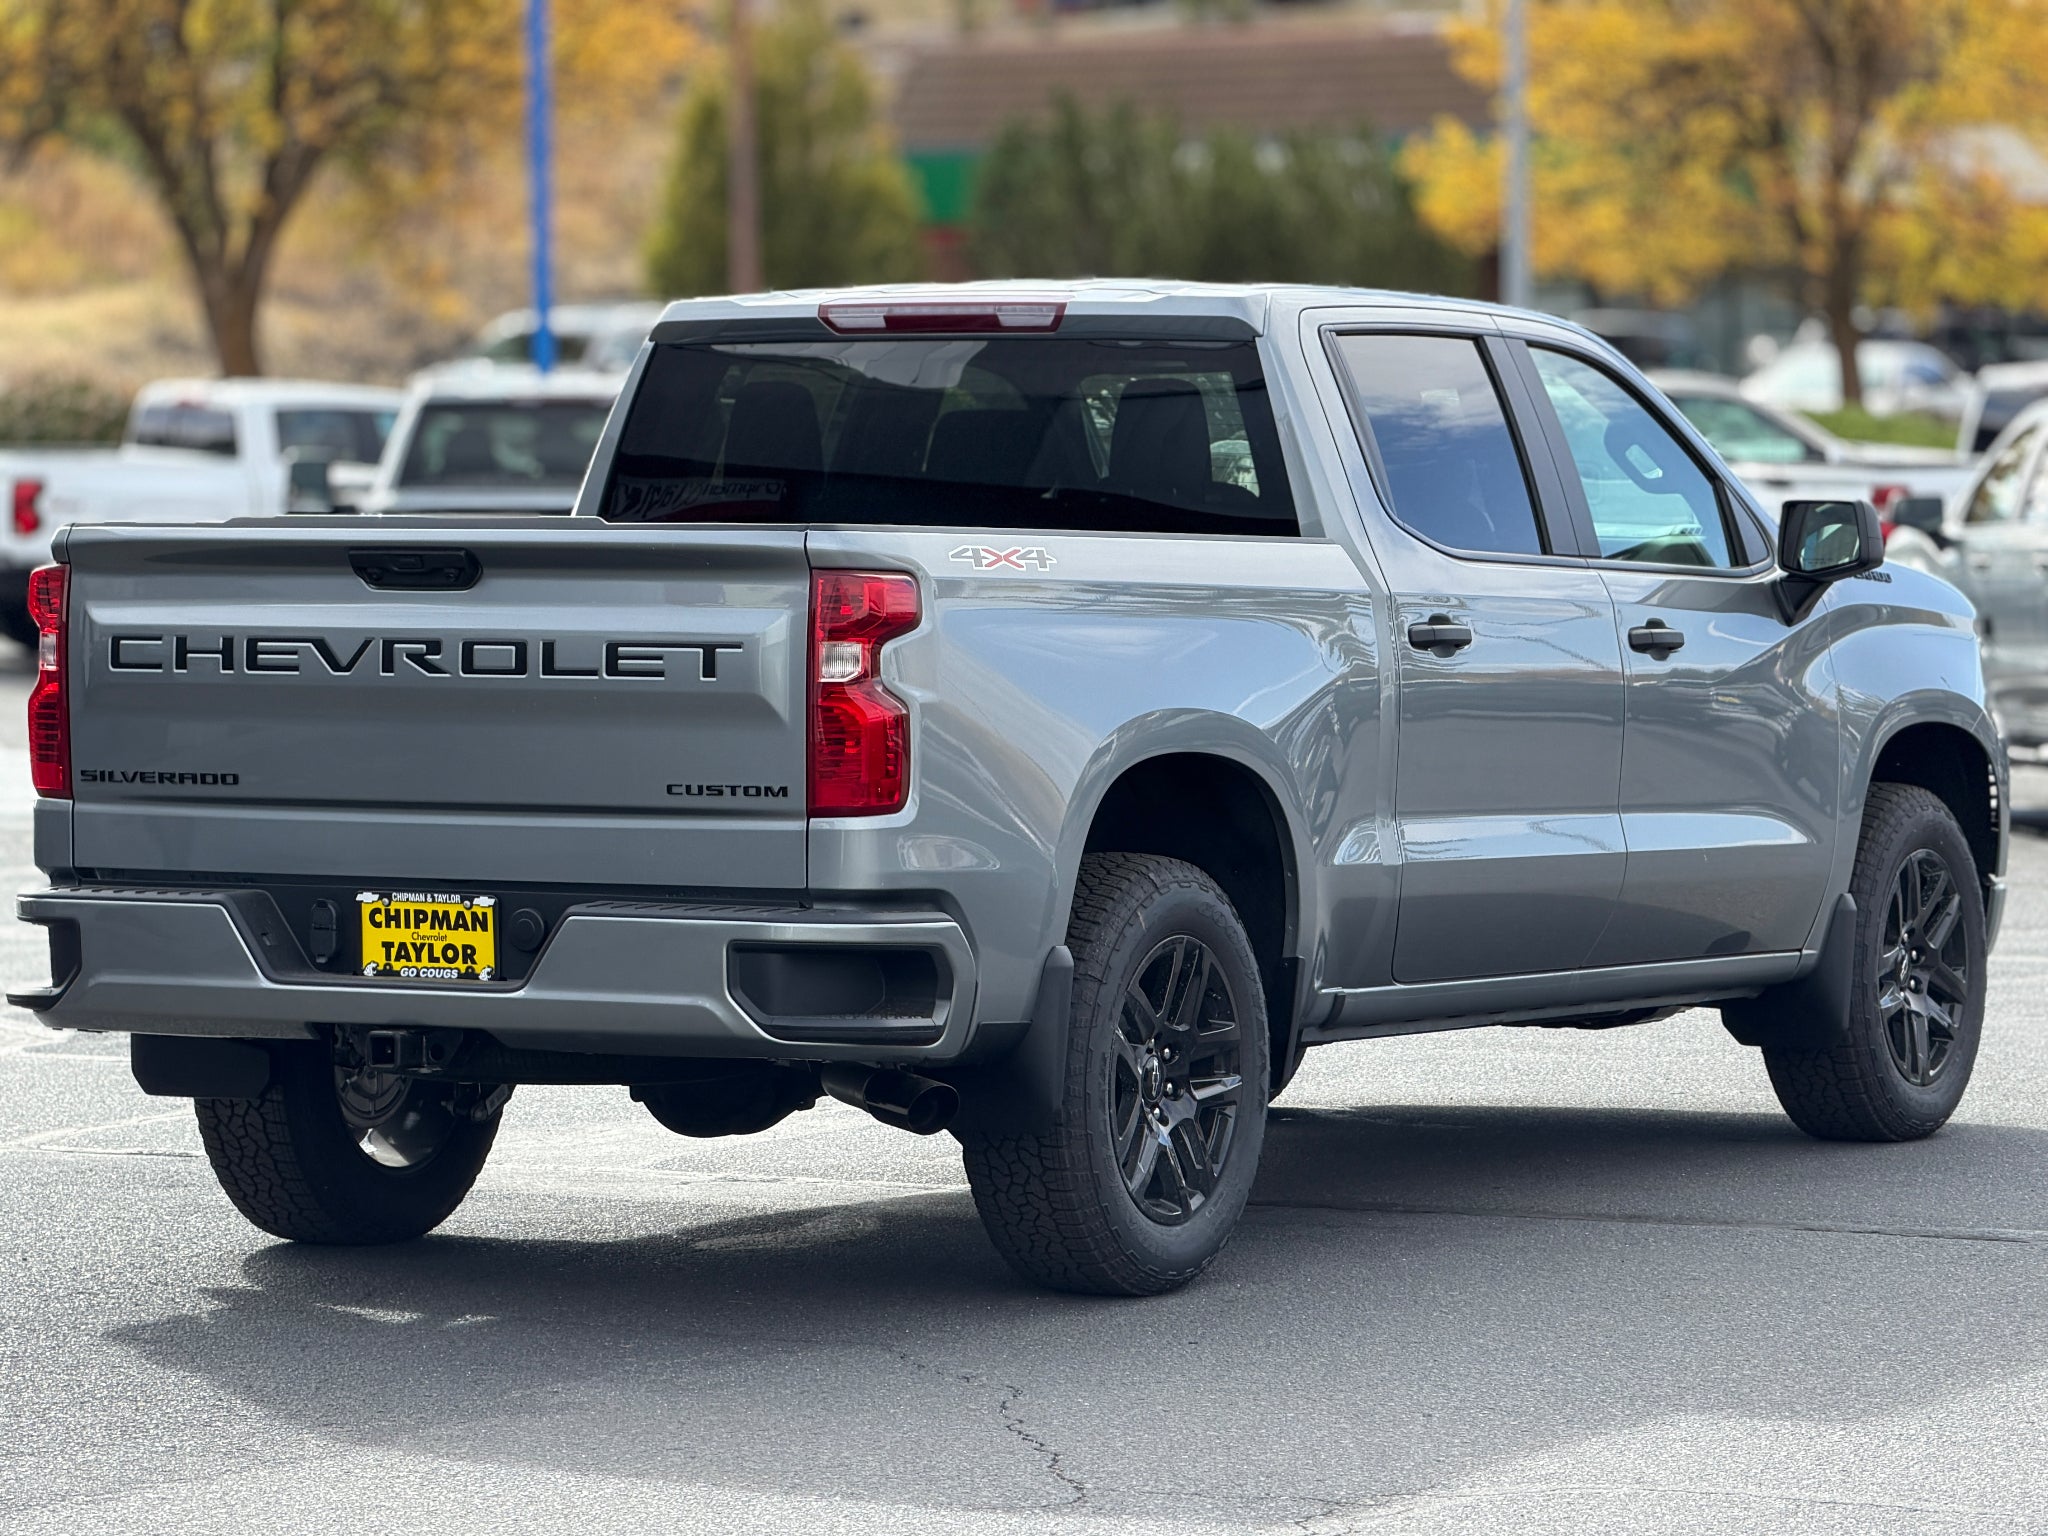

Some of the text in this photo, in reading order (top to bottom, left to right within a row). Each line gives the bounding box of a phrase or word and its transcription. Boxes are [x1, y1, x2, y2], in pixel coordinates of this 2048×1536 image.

[108, 634, 744, 681] CHEVROLET
[80, 769, 239, 785] SILVERADO
[666, 784, 788, 797] CUSTOM
[391, 893, 461, 904] CHIPMAN & TAYLOR
[368, 907, 489, 932] CHIPMAN
[411, 932, 448, 942] Chevrolet
[381, 941, 477, 965] TAYLOR
[400, 967, 459, 979] GO COUGS
